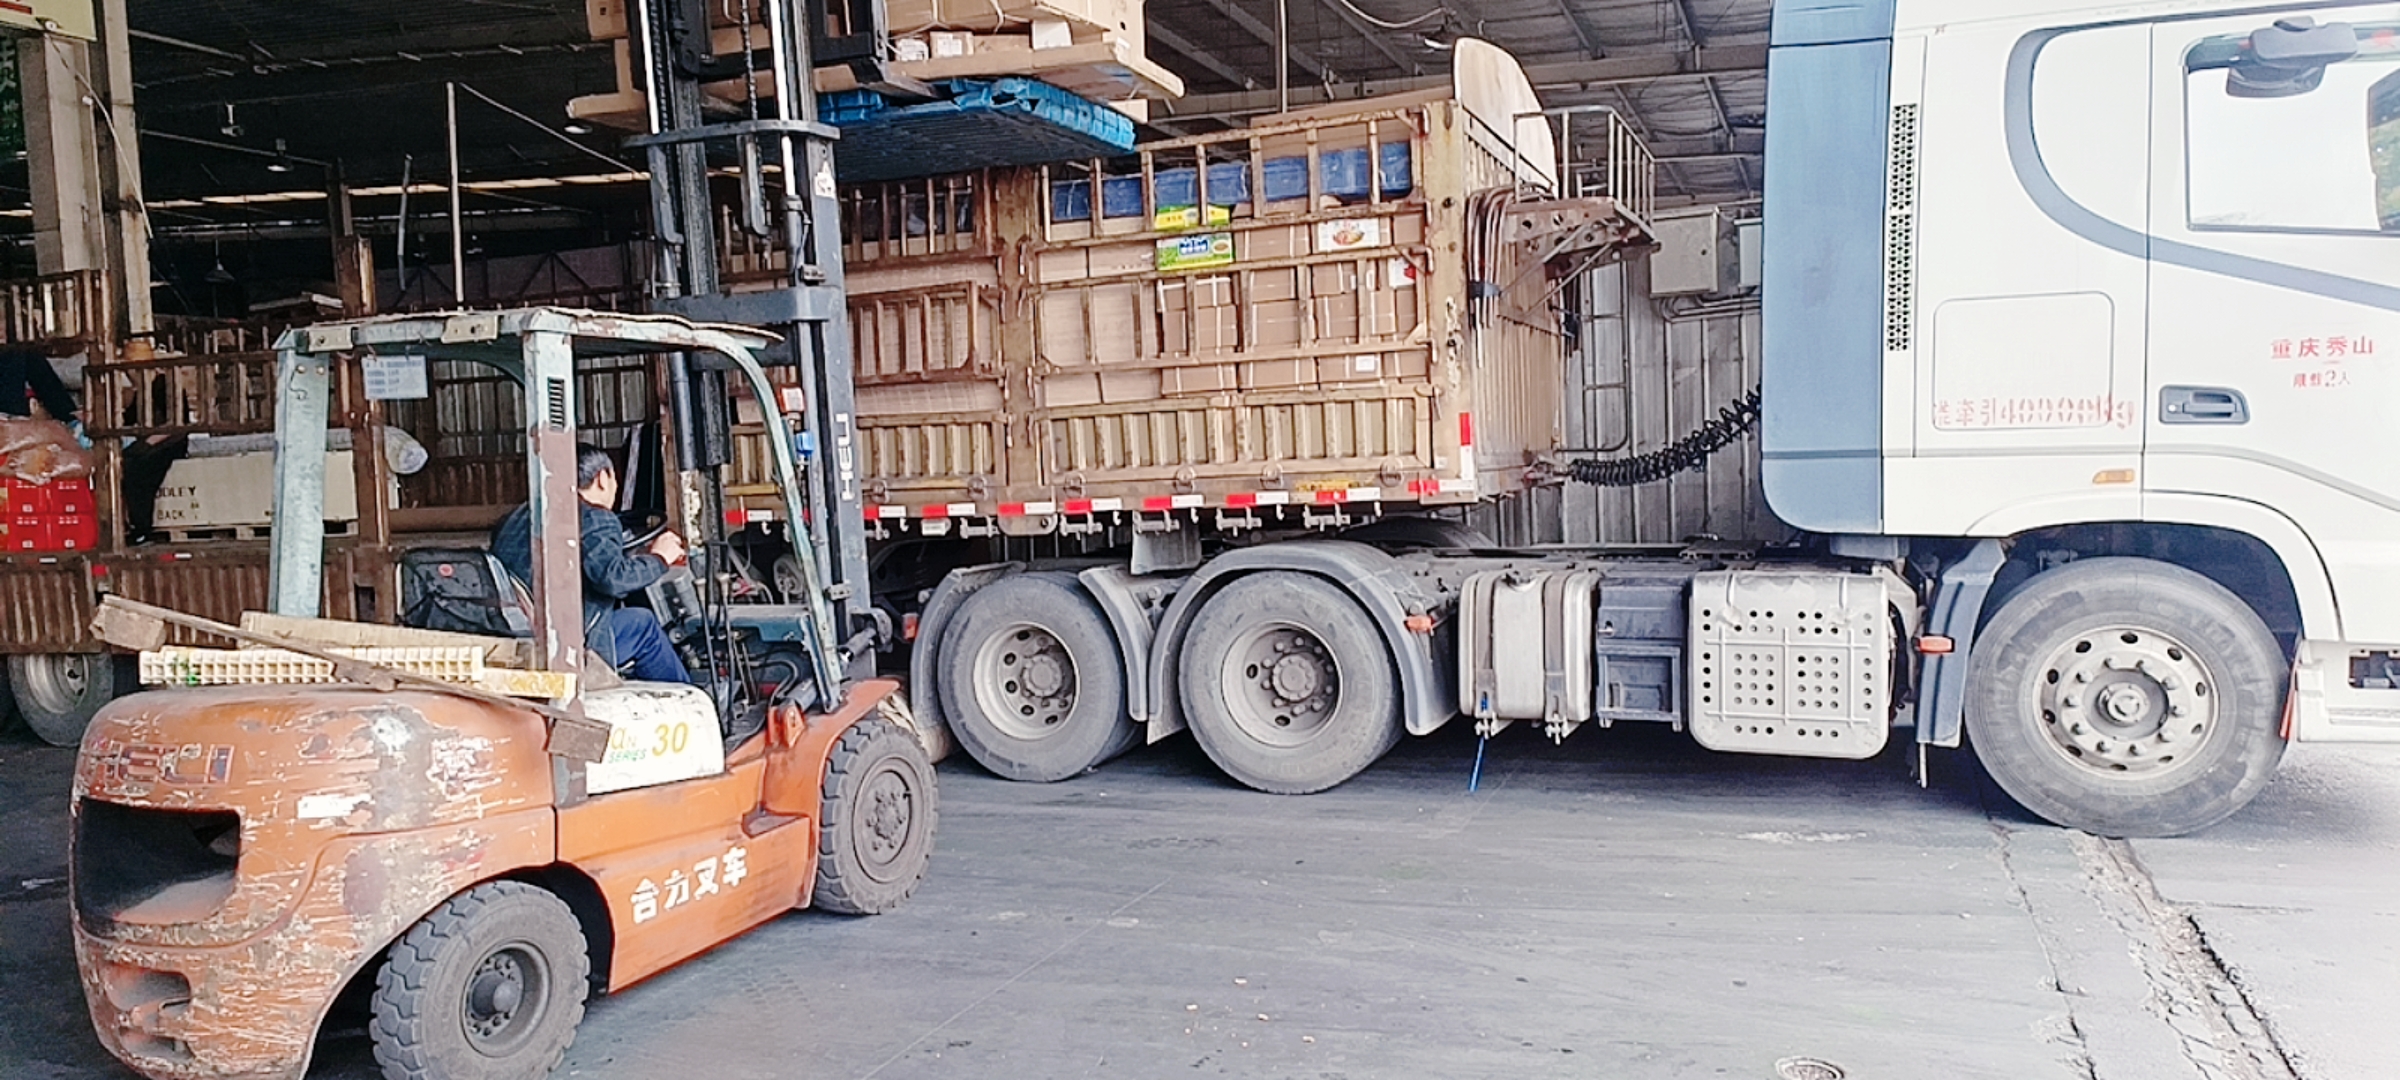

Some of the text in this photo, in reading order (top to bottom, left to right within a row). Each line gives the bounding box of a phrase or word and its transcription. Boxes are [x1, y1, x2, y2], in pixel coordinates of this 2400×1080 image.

[2271, 335, 2373, 359] 重庆秀山
[651, 721, 690, 757] 30
[629, 845, 749, 925] 合力叉车
